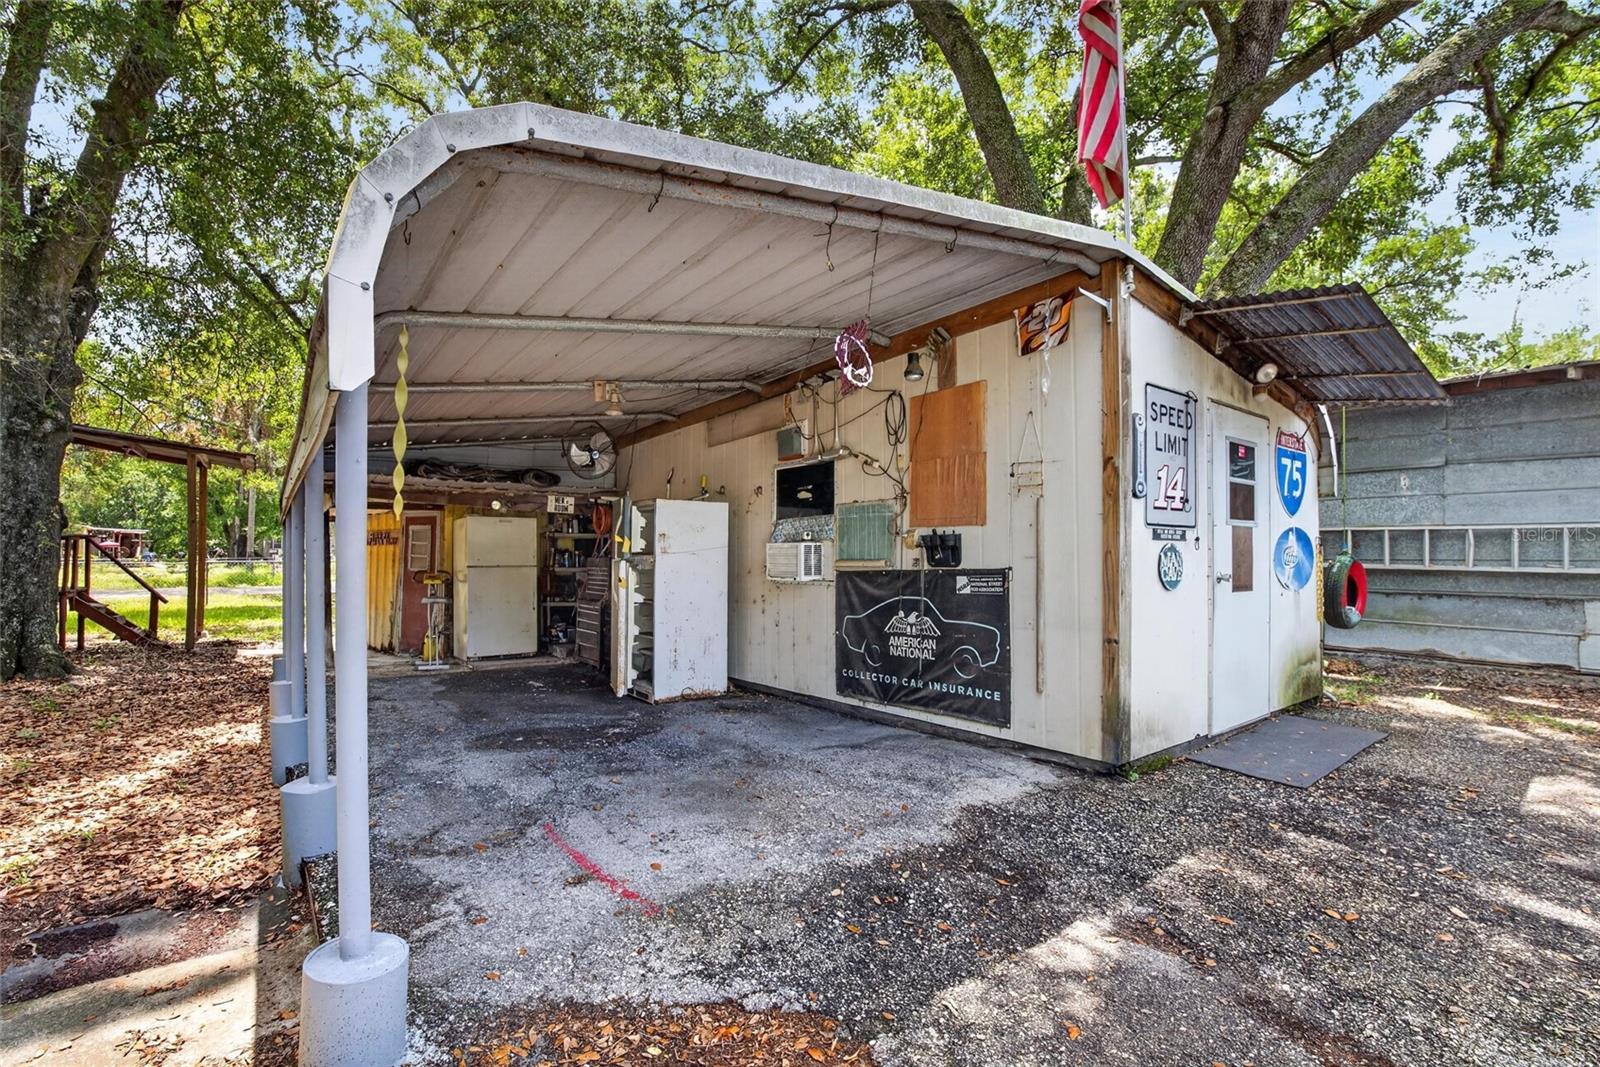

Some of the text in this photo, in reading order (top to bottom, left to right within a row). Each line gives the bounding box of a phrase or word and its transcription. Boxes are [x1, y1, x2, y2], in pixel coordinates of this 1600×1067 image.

[1150, 401, 1193, 431] SPEED
[1154, 431, 1189, 457] LIMIT
[1153, 464, 1186, 511] 14
[1281, 457, 1302, 500] 75
[888, 635, 937, 650] AMERICAN
[889, 646, 936, 661] NATIONAL
[842, 668, 1001, 701] COLLECTOR CAR INSURANCE
